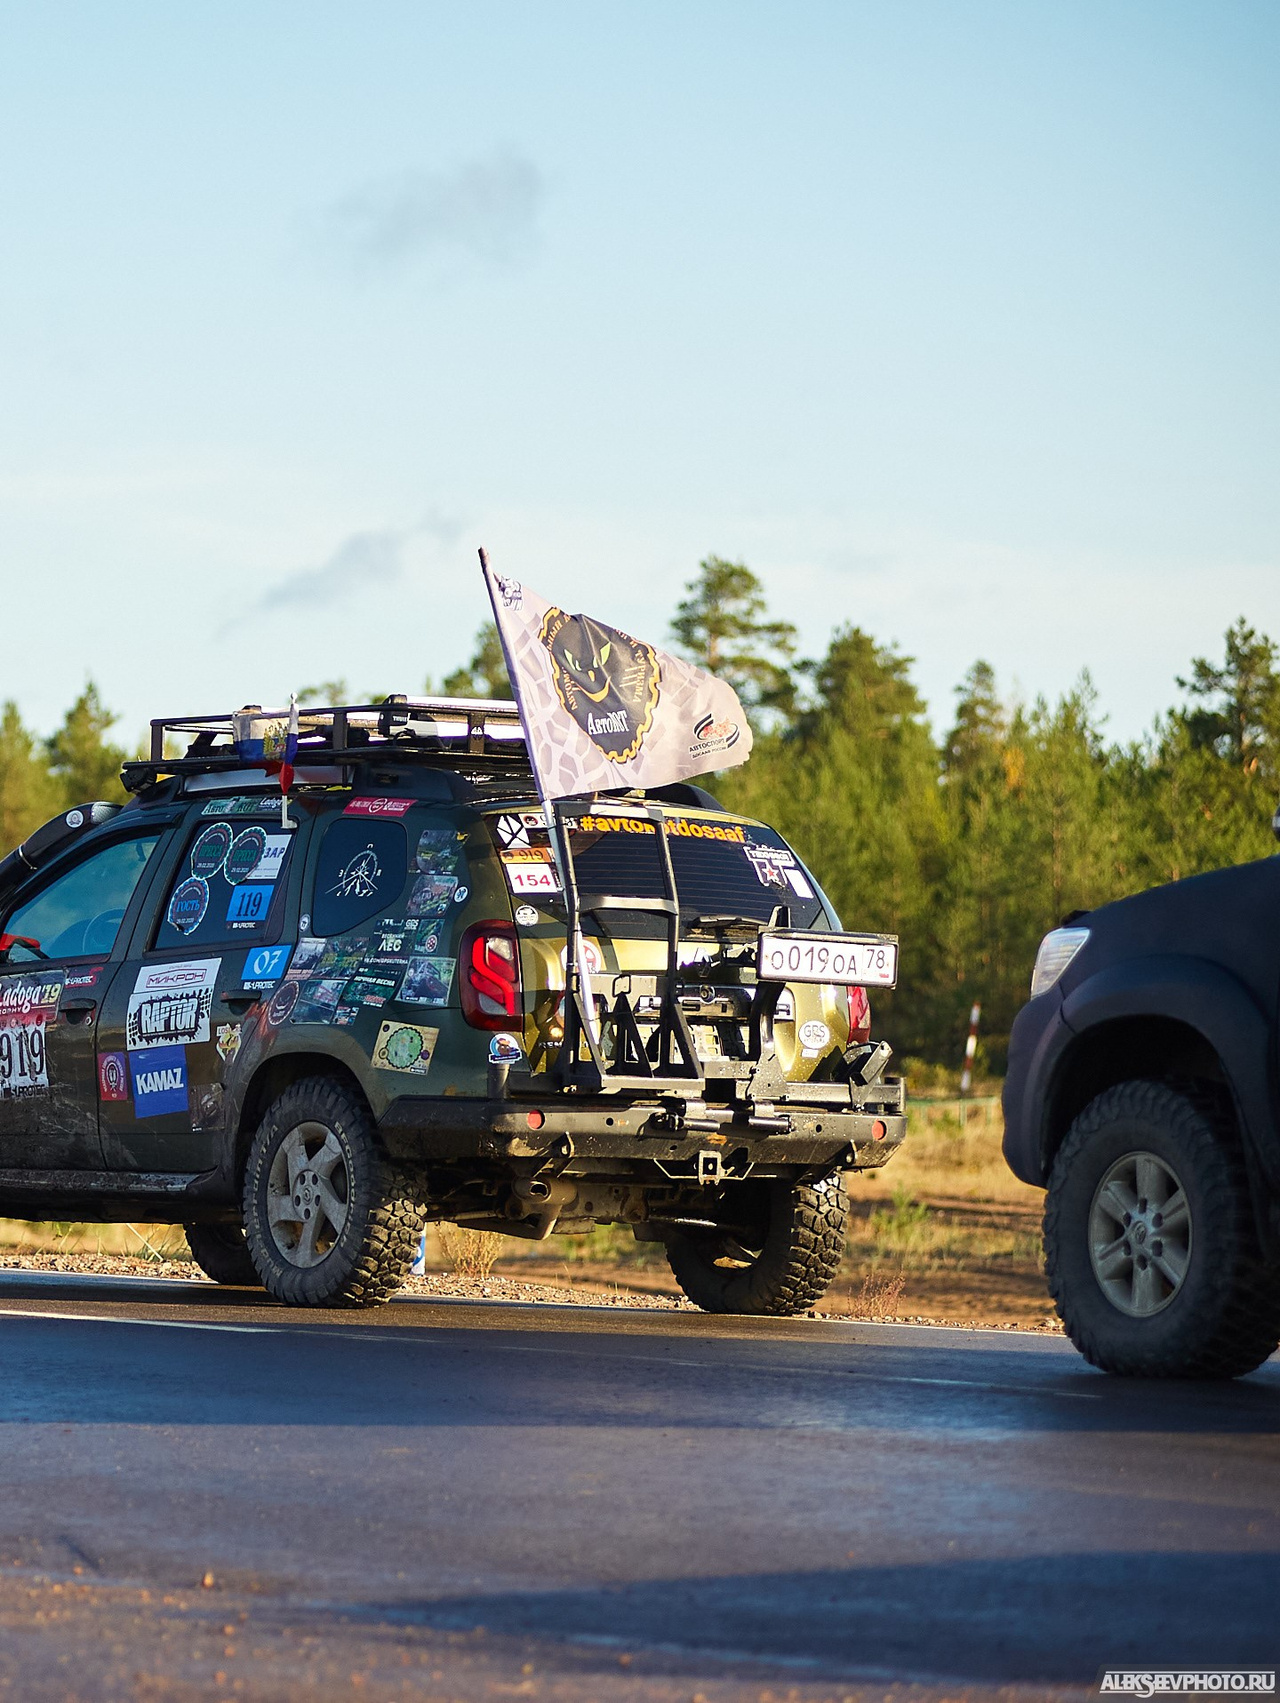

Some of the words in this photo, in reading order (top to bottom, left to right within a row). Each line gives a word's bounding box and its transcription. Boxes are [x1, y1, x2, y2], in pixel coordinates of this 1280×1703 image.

[514, 874, 551, 887] 154
[236, 892, 263, 917] 119
[867, 949, 885, 969] 78
[149, 972, 206, 984] МИКРОН
[141, 998, 198, 1034] RAPTOR
[136, 1067, 184, 1095] KAMAZ
